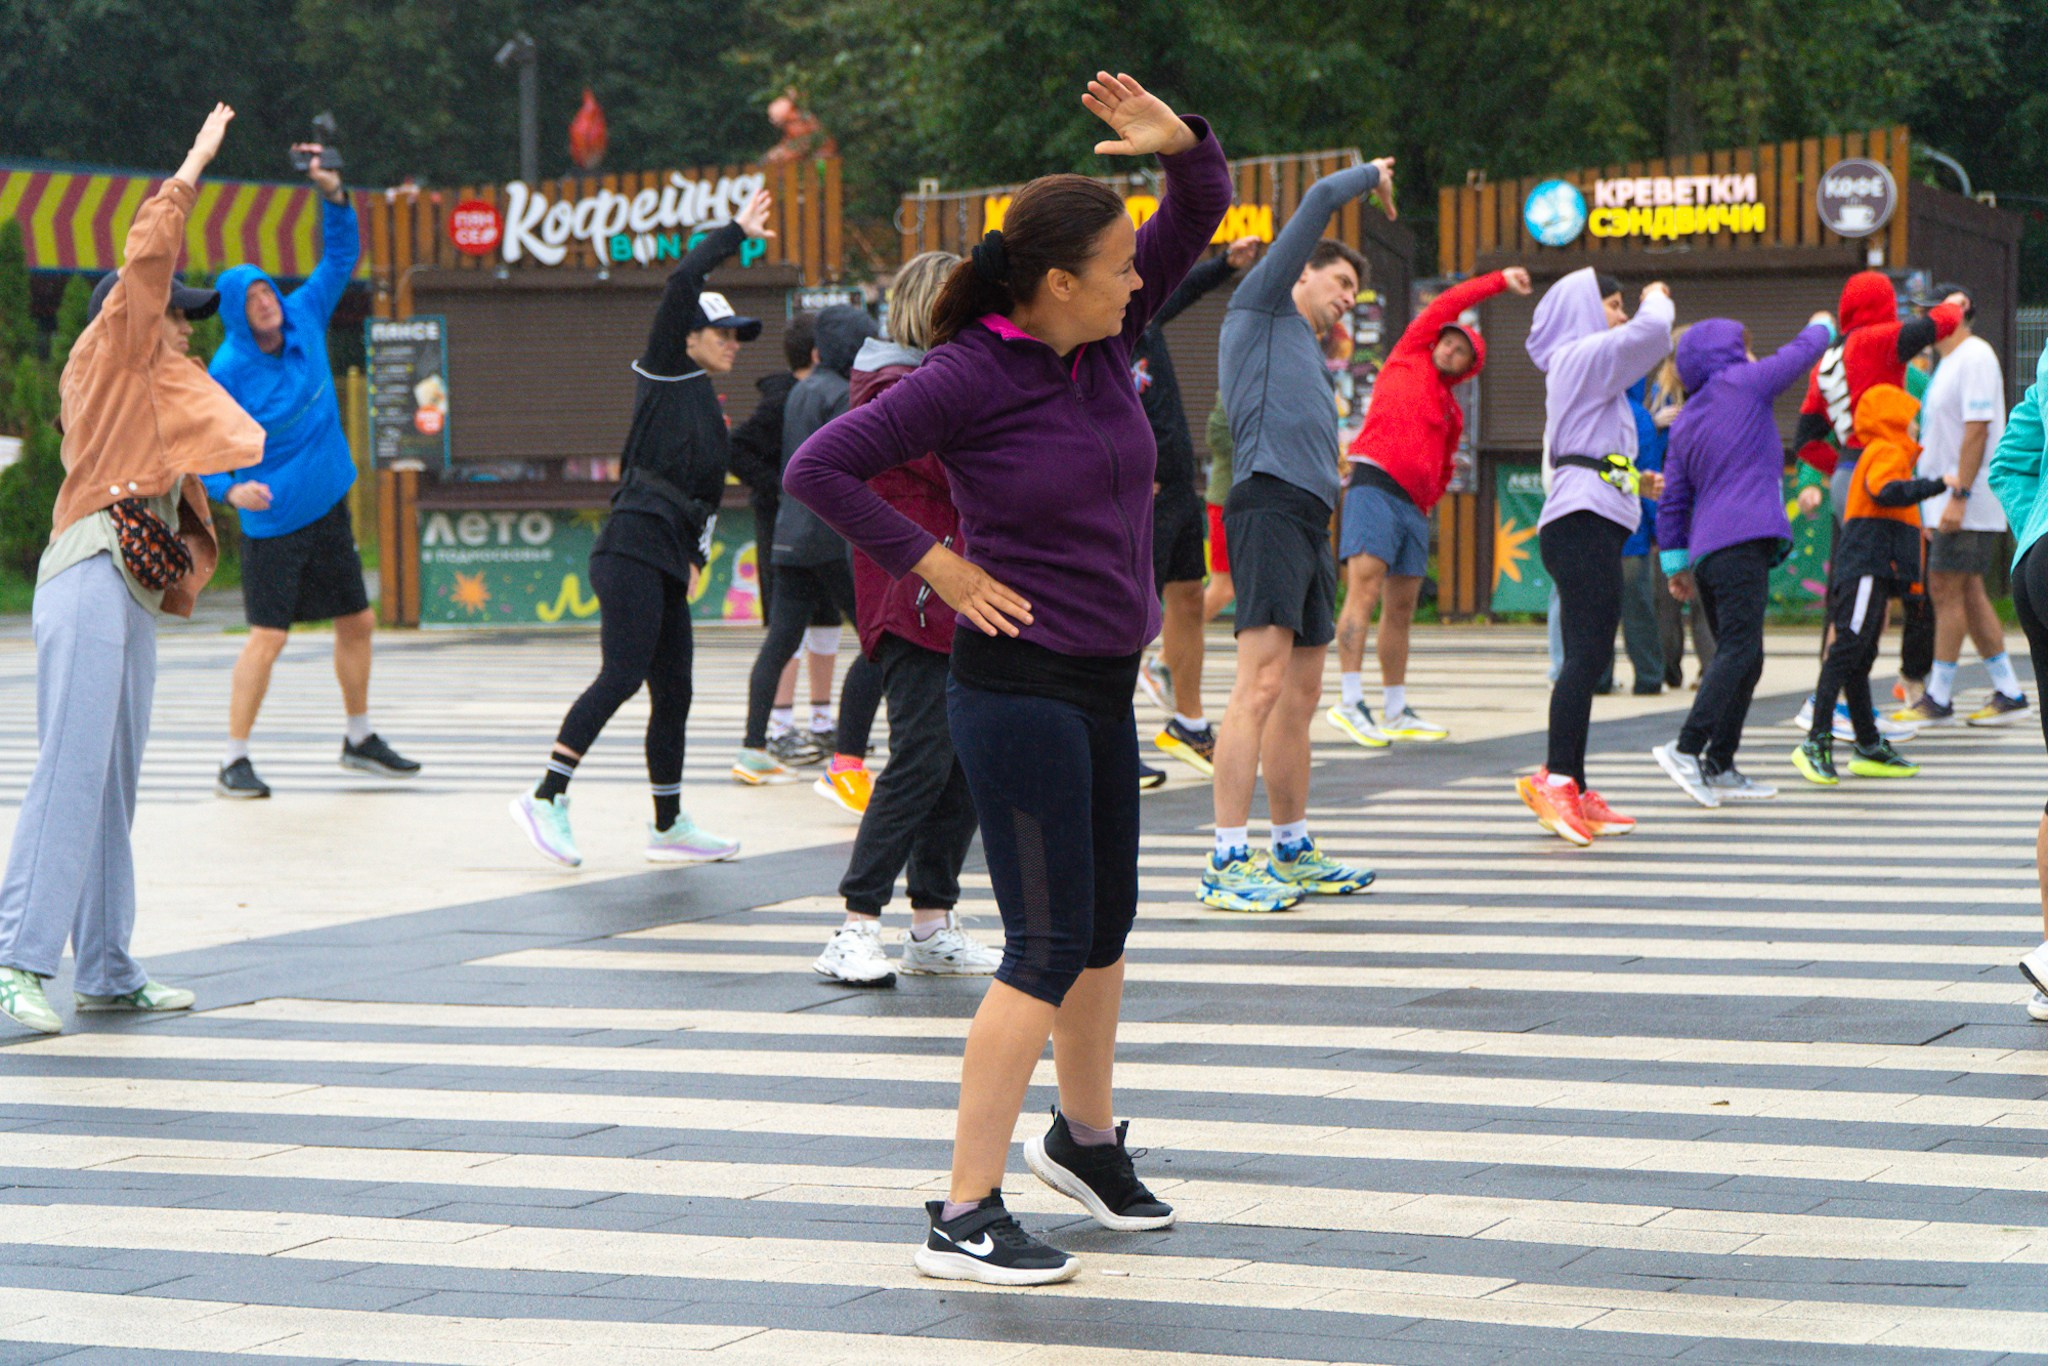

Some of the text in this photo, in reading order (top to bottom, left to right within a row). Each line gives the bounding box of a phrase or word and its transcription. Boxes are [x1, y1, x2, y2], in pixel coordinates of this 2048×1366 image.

[1594, 173, 1757, 207] КРЕВЕТКИ
[1824, 175, 1885, 199] КОФЕ
[1588, 202, 1766, 241] СЭНДВИЧИ
